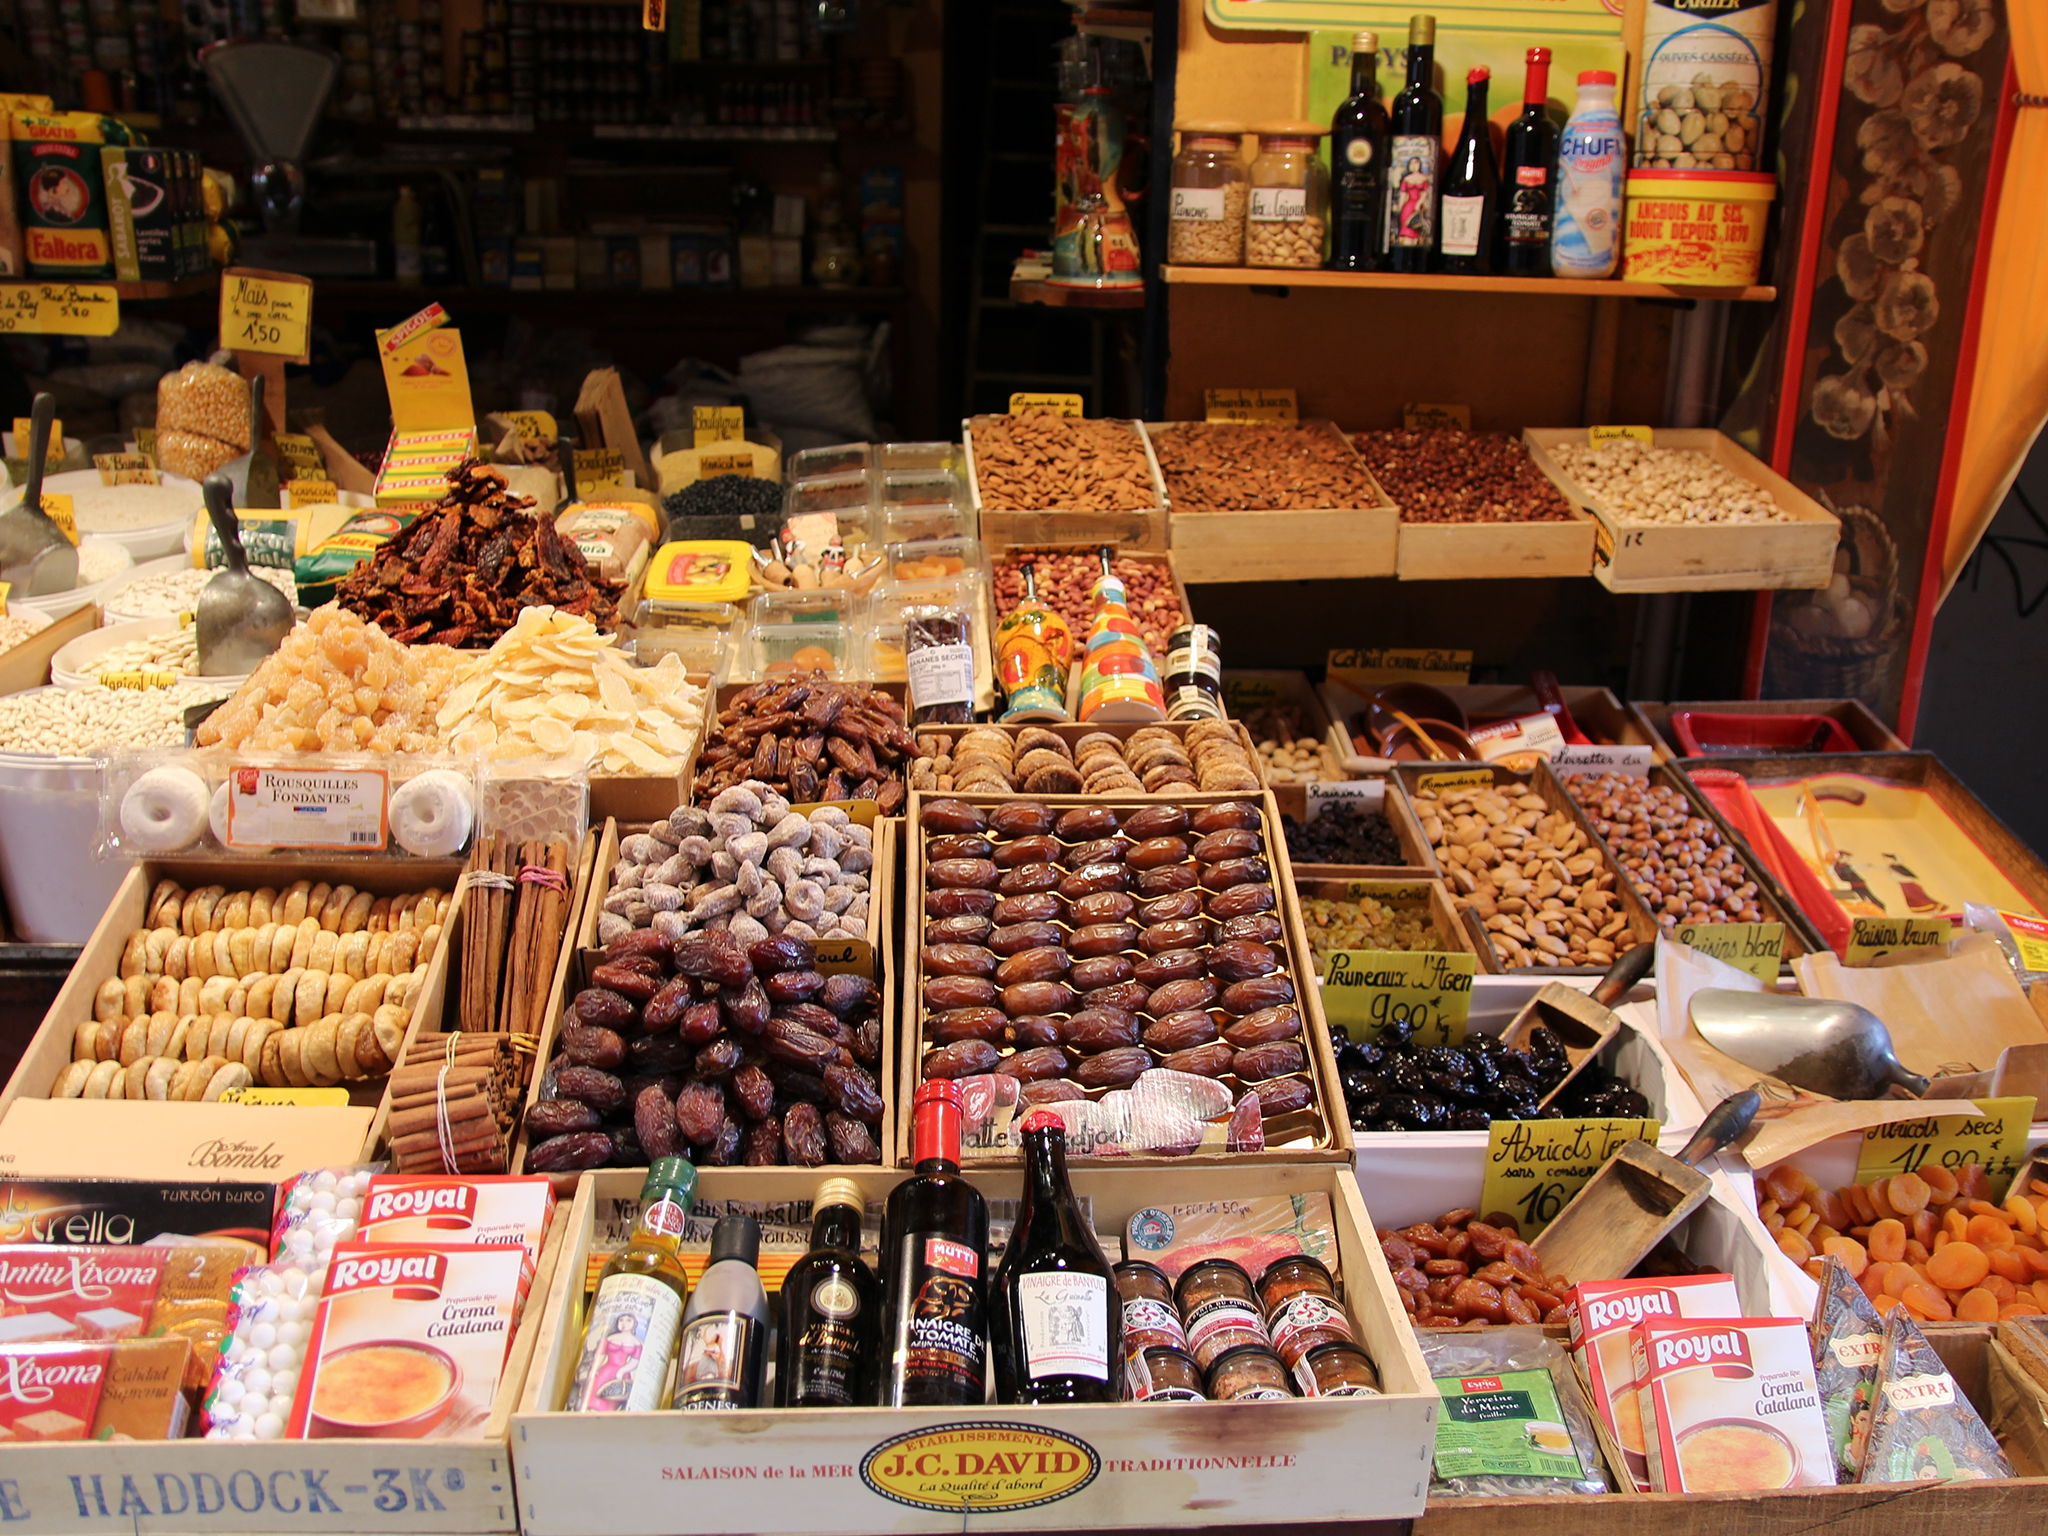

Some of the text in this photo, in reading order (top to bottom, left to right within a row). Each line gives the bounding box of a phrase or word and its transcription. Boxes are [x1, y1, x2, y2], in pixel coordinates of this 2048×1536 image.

[29, 126, 77, 139] GRATIS
[1637, 201, 1745, 223] ANCHOIS AU SEL
[1671, 222, 1718, 241] DEPUIS
[32, 233, 99, 260] Fallera
[139, 252, 167, 262] France
[390, 309, 433, 346] SPIGOL
[1742, 925, 1783, 958] blond
[1852, 918, 1900, 948] Raisins
[1955, 1118, 2004, 1137] secs
[188, 1137, 285, 1170] Bomba
[1493, 1122, 1593, 1163] Abricots
[368, 1186, 468, 1220] Royal
[932, 1242, 974, 1265] MUTTI
[331, 1254, 438, 1290] Royal
[1022, 1274, 1106, 1293] VINAIGRE de BANYULS
[441, 1302, 497, 1321] Crema
[1587, 1290, 1674, 1330] Royal
[426, 1317, 505, 1339] Catalana
[900, 1317, 987, 1354] VINAIGRE DE
[917, 1329, 978, 1356] TOMATE
[1654, 1330, 1744, 1369] Royal
[1466, 1379, 1498, 1389] ESPIG
[1760, 1380, 1806, 1399] Crema
[1890, 1380, 1951, 1402] EXTRA
[1460, 1394, 1515, 1406] Verveine
[1460, 1405, 1477, 1416] du
[1754, 1394, 1818, 1417] Catalana
[904, 1431, 1056, 1452] ETABLISSEMENTS
[661, 1465, 759, 1481] SALAISON
[763, 1464, 785, 1480] de
[789, 1465, 807, 1480] la
[811, 1465, 855, 1480] MER
[954, 1450, 1081, 1477] DAVID
[1105, 1453, 1298, 1474] TRADITIONNELLE
[917, 1477, 1048, 1496] La Qualité d'abord
